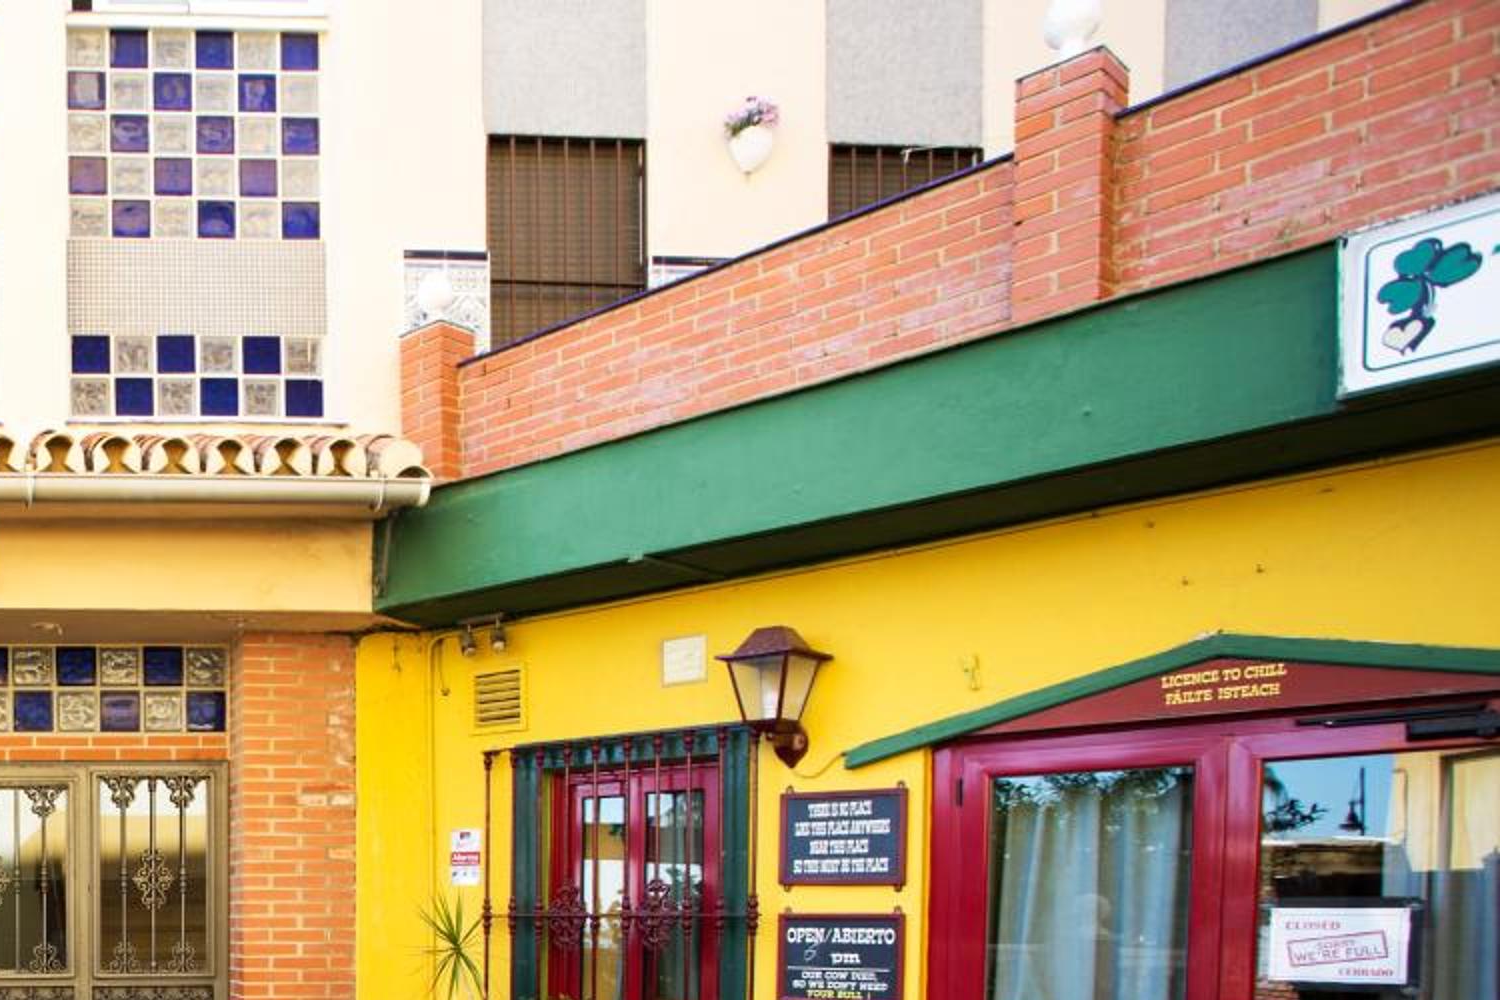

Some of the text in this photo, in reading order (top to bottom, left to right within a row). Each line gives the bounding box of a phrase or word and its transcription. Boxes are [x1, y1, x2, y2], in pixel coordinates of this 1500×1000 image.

[1161, 663, 1287, 689] LICENCE TO CHILL
[1217, 683, 1281, 699] ISTEACH
[850, 800, 873, 816] PLACE
[827, 820, 849, 836] PLACE
[850, 818, 891, 835] ANYWHERE
[846, 838, 869, 854] PLACE
[866, 857, 889, 872] PLACE
[830, 953, 861, 966] pm
[1294, 945, 1383, 961] WE'RE FULL
[824, 971, 849, 980] COW
[808, 980, 825, 990] WE
